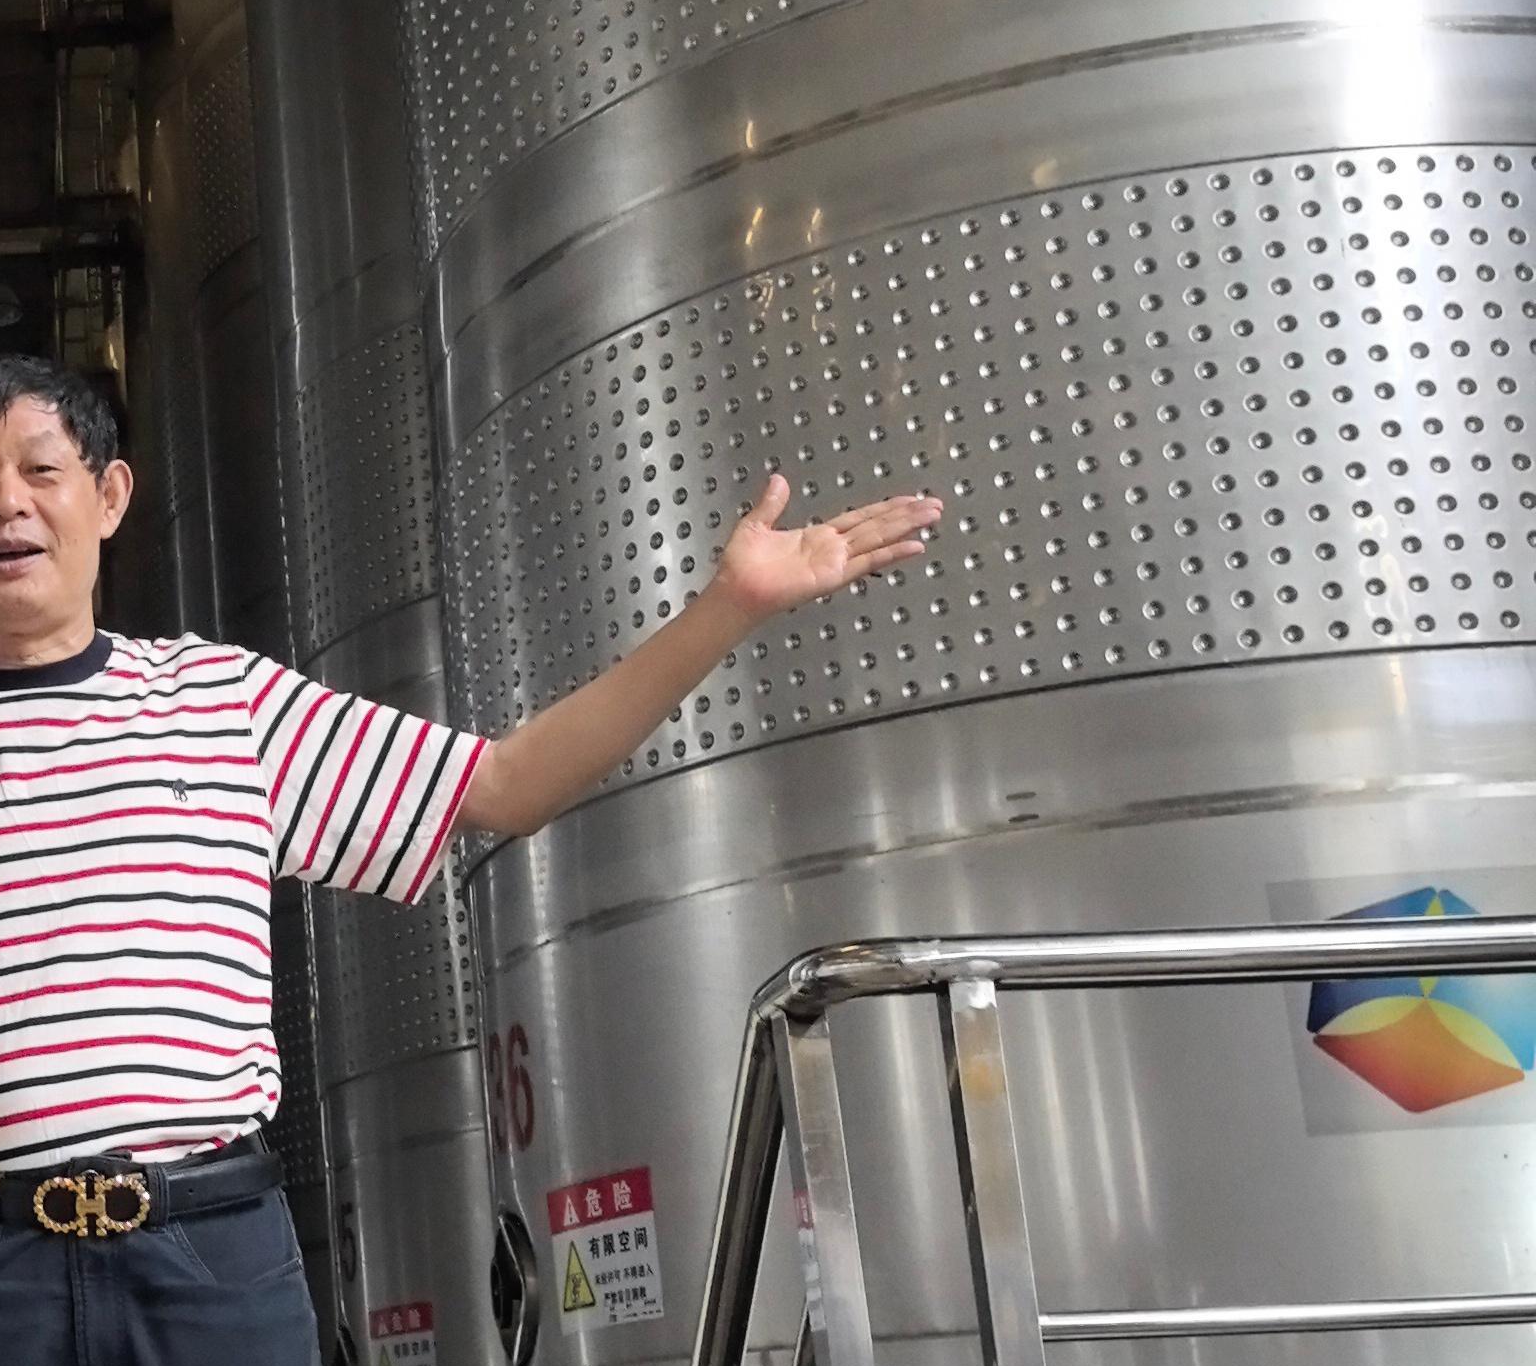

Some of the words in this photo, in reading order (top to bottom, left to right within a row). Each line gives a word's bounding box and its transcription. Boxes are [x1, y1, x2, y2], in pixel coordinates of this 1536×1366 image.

[585, 1180, 633, 1218] 危险
[588, 1227, 649, 1260] 有限空间
